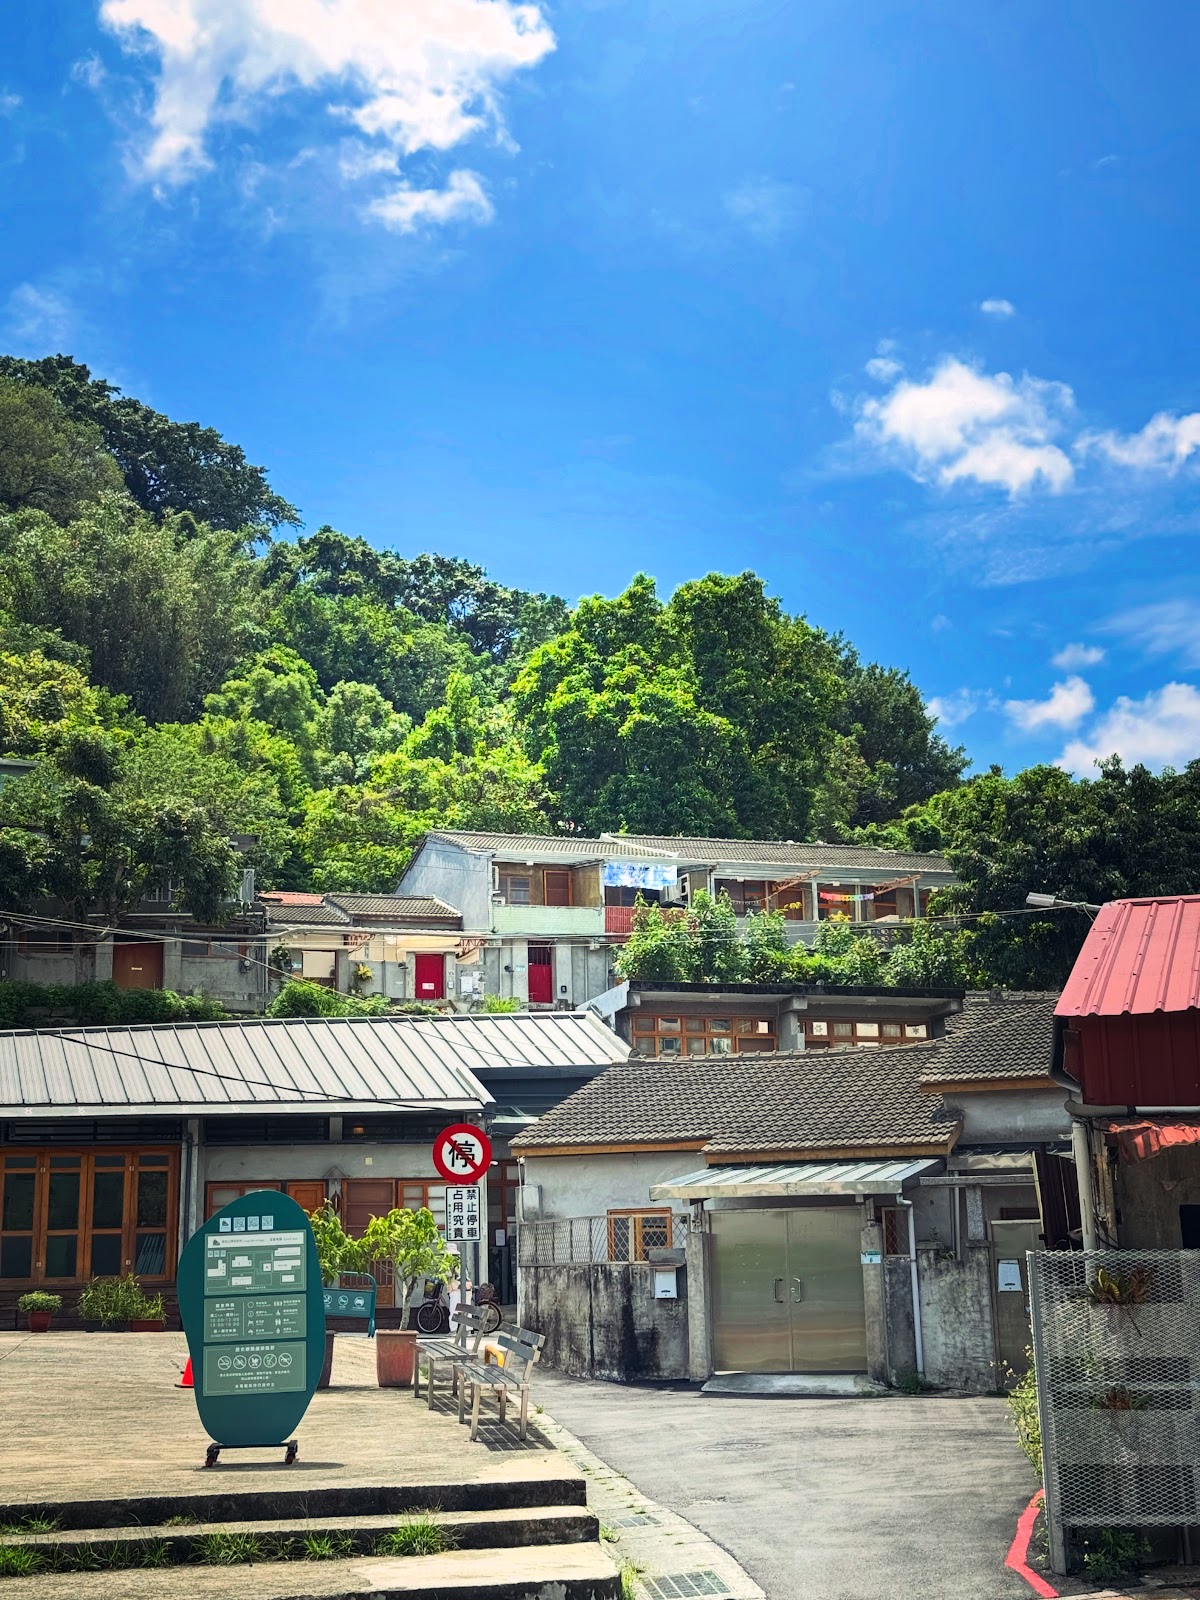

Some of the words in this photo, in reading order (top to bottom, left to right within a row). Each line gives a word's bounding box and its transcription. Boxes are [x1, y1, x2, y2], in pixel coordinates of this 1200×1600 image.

[449, 1141, 475, 1167] 停
[453, 1189, 464, 1239] 占用究責
[467, 1189, 477, 1238] 禁止停車
